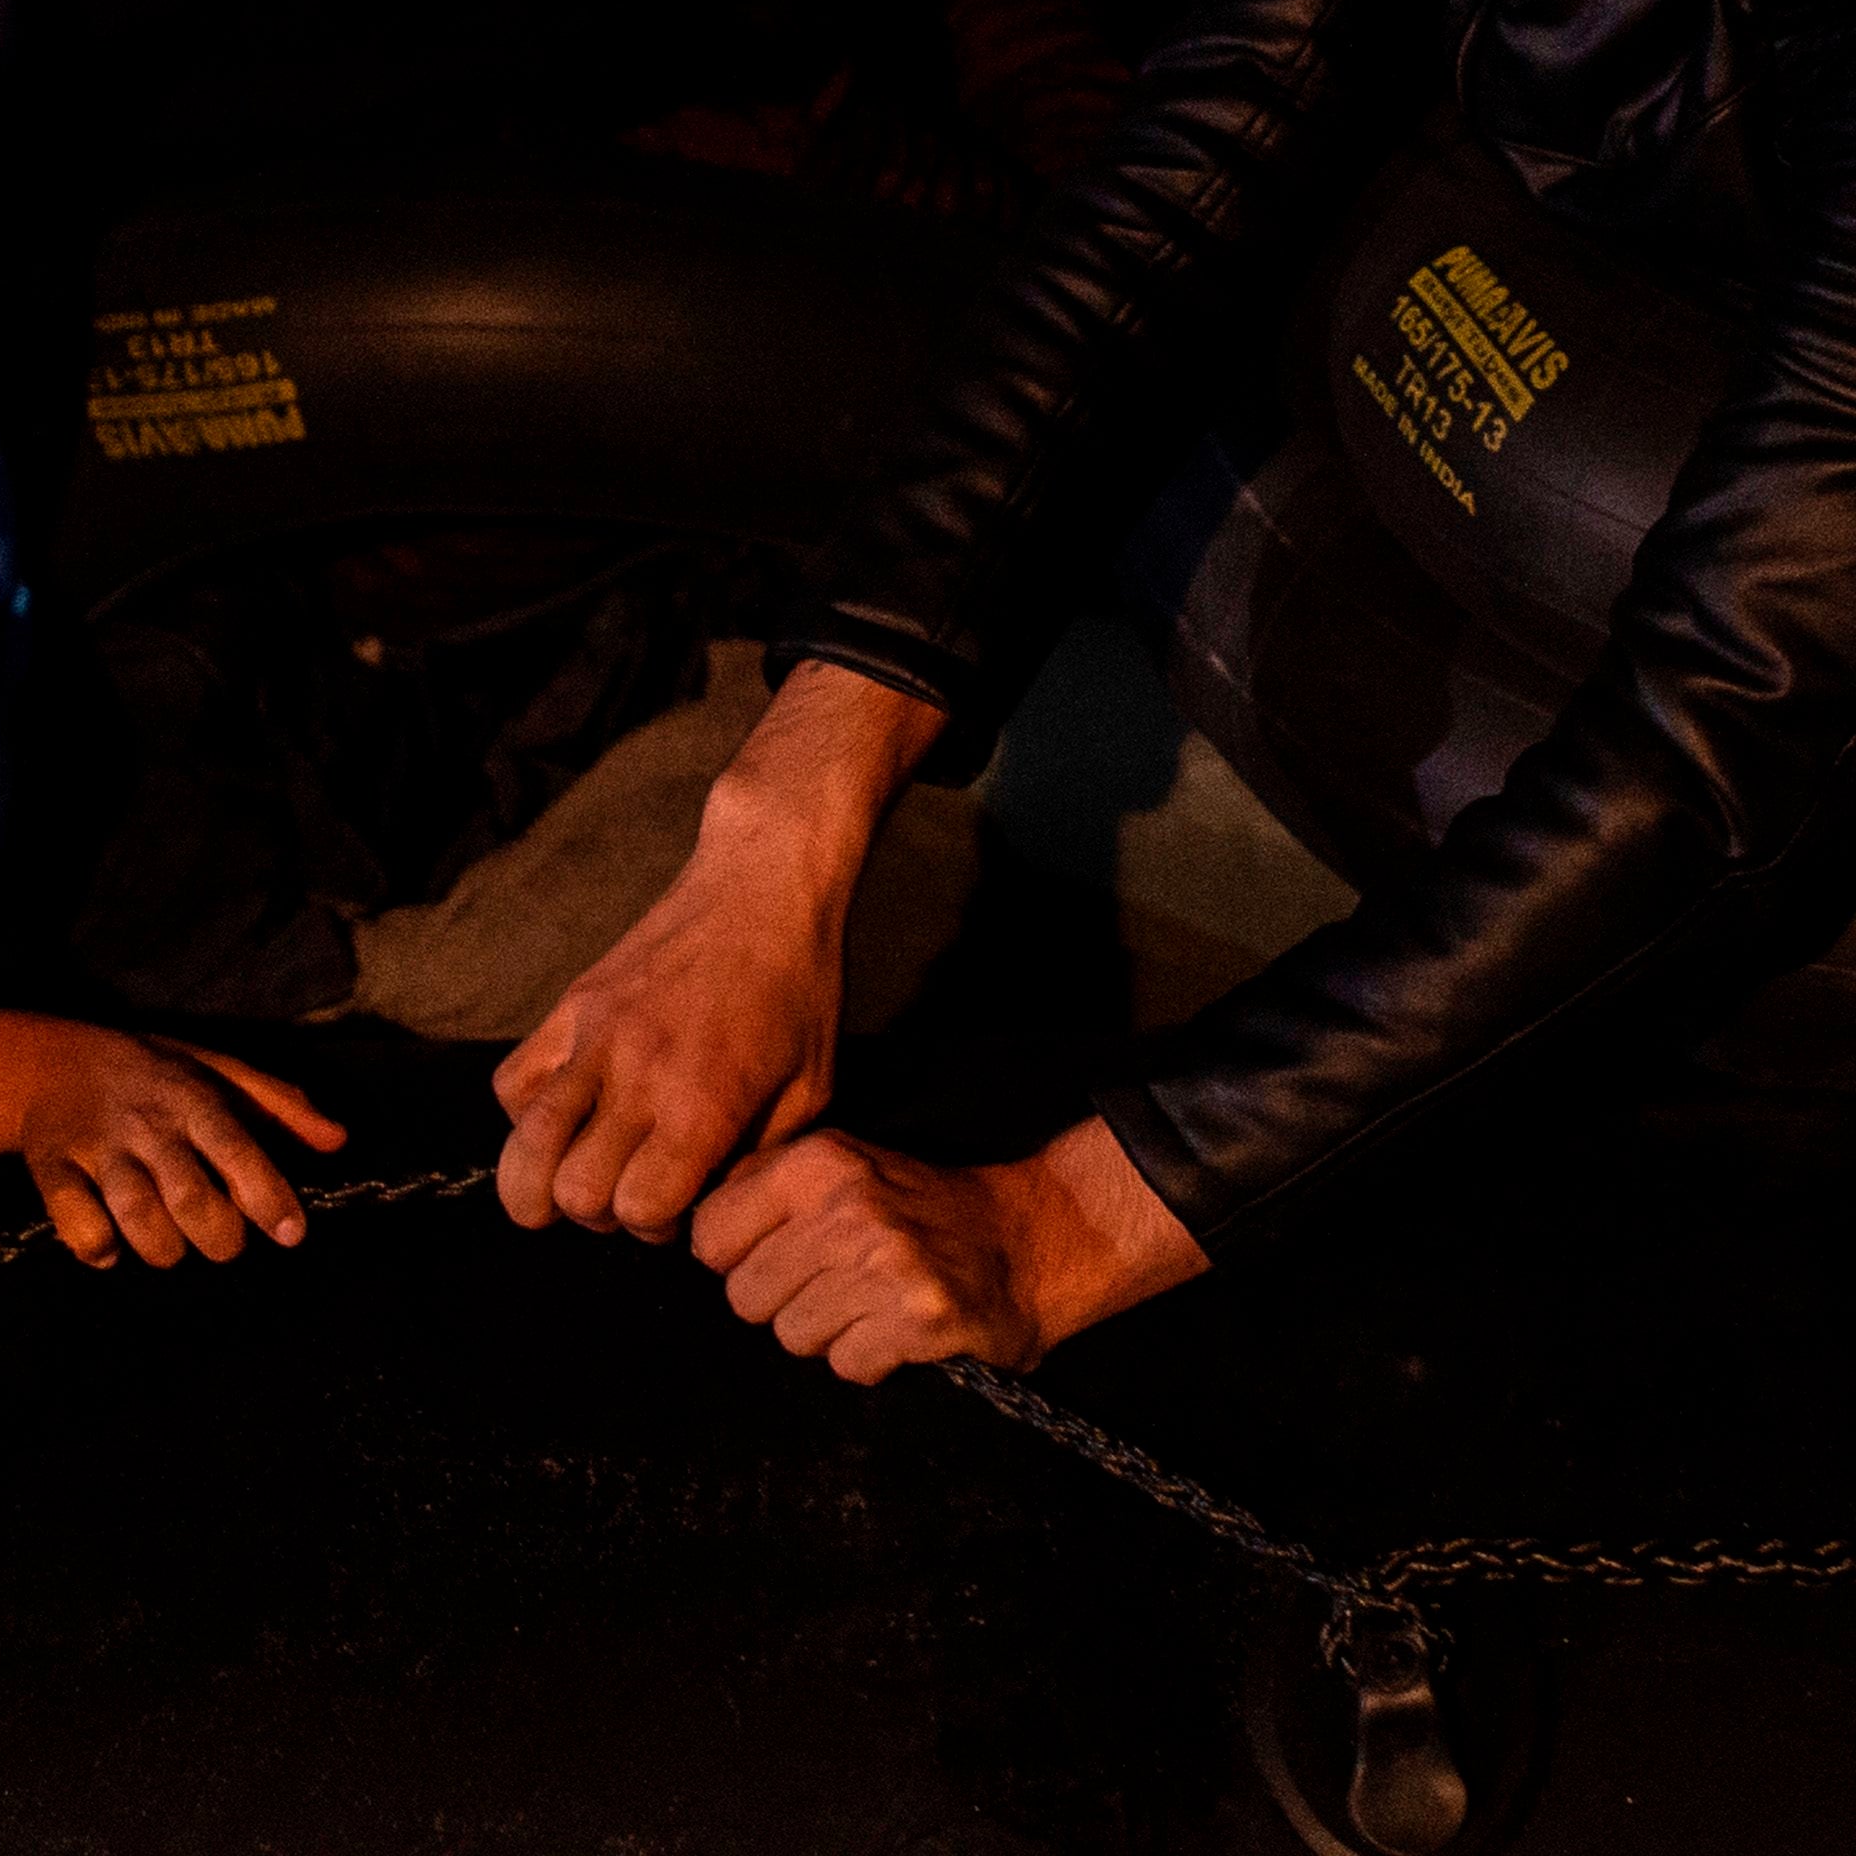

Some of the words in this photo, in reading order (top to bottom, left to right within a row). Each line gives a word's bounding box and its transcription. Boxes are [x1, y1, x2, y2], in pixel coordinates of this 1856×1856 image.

[1352, 355, 1398, 417] MADE
[1397, 411, 1420, 444] IN
[1419, 440, 1477, 517] INDIA
[1390, 295, 1509, 452] 165/175-13
[1395, 353, 1453, 440] TR13
